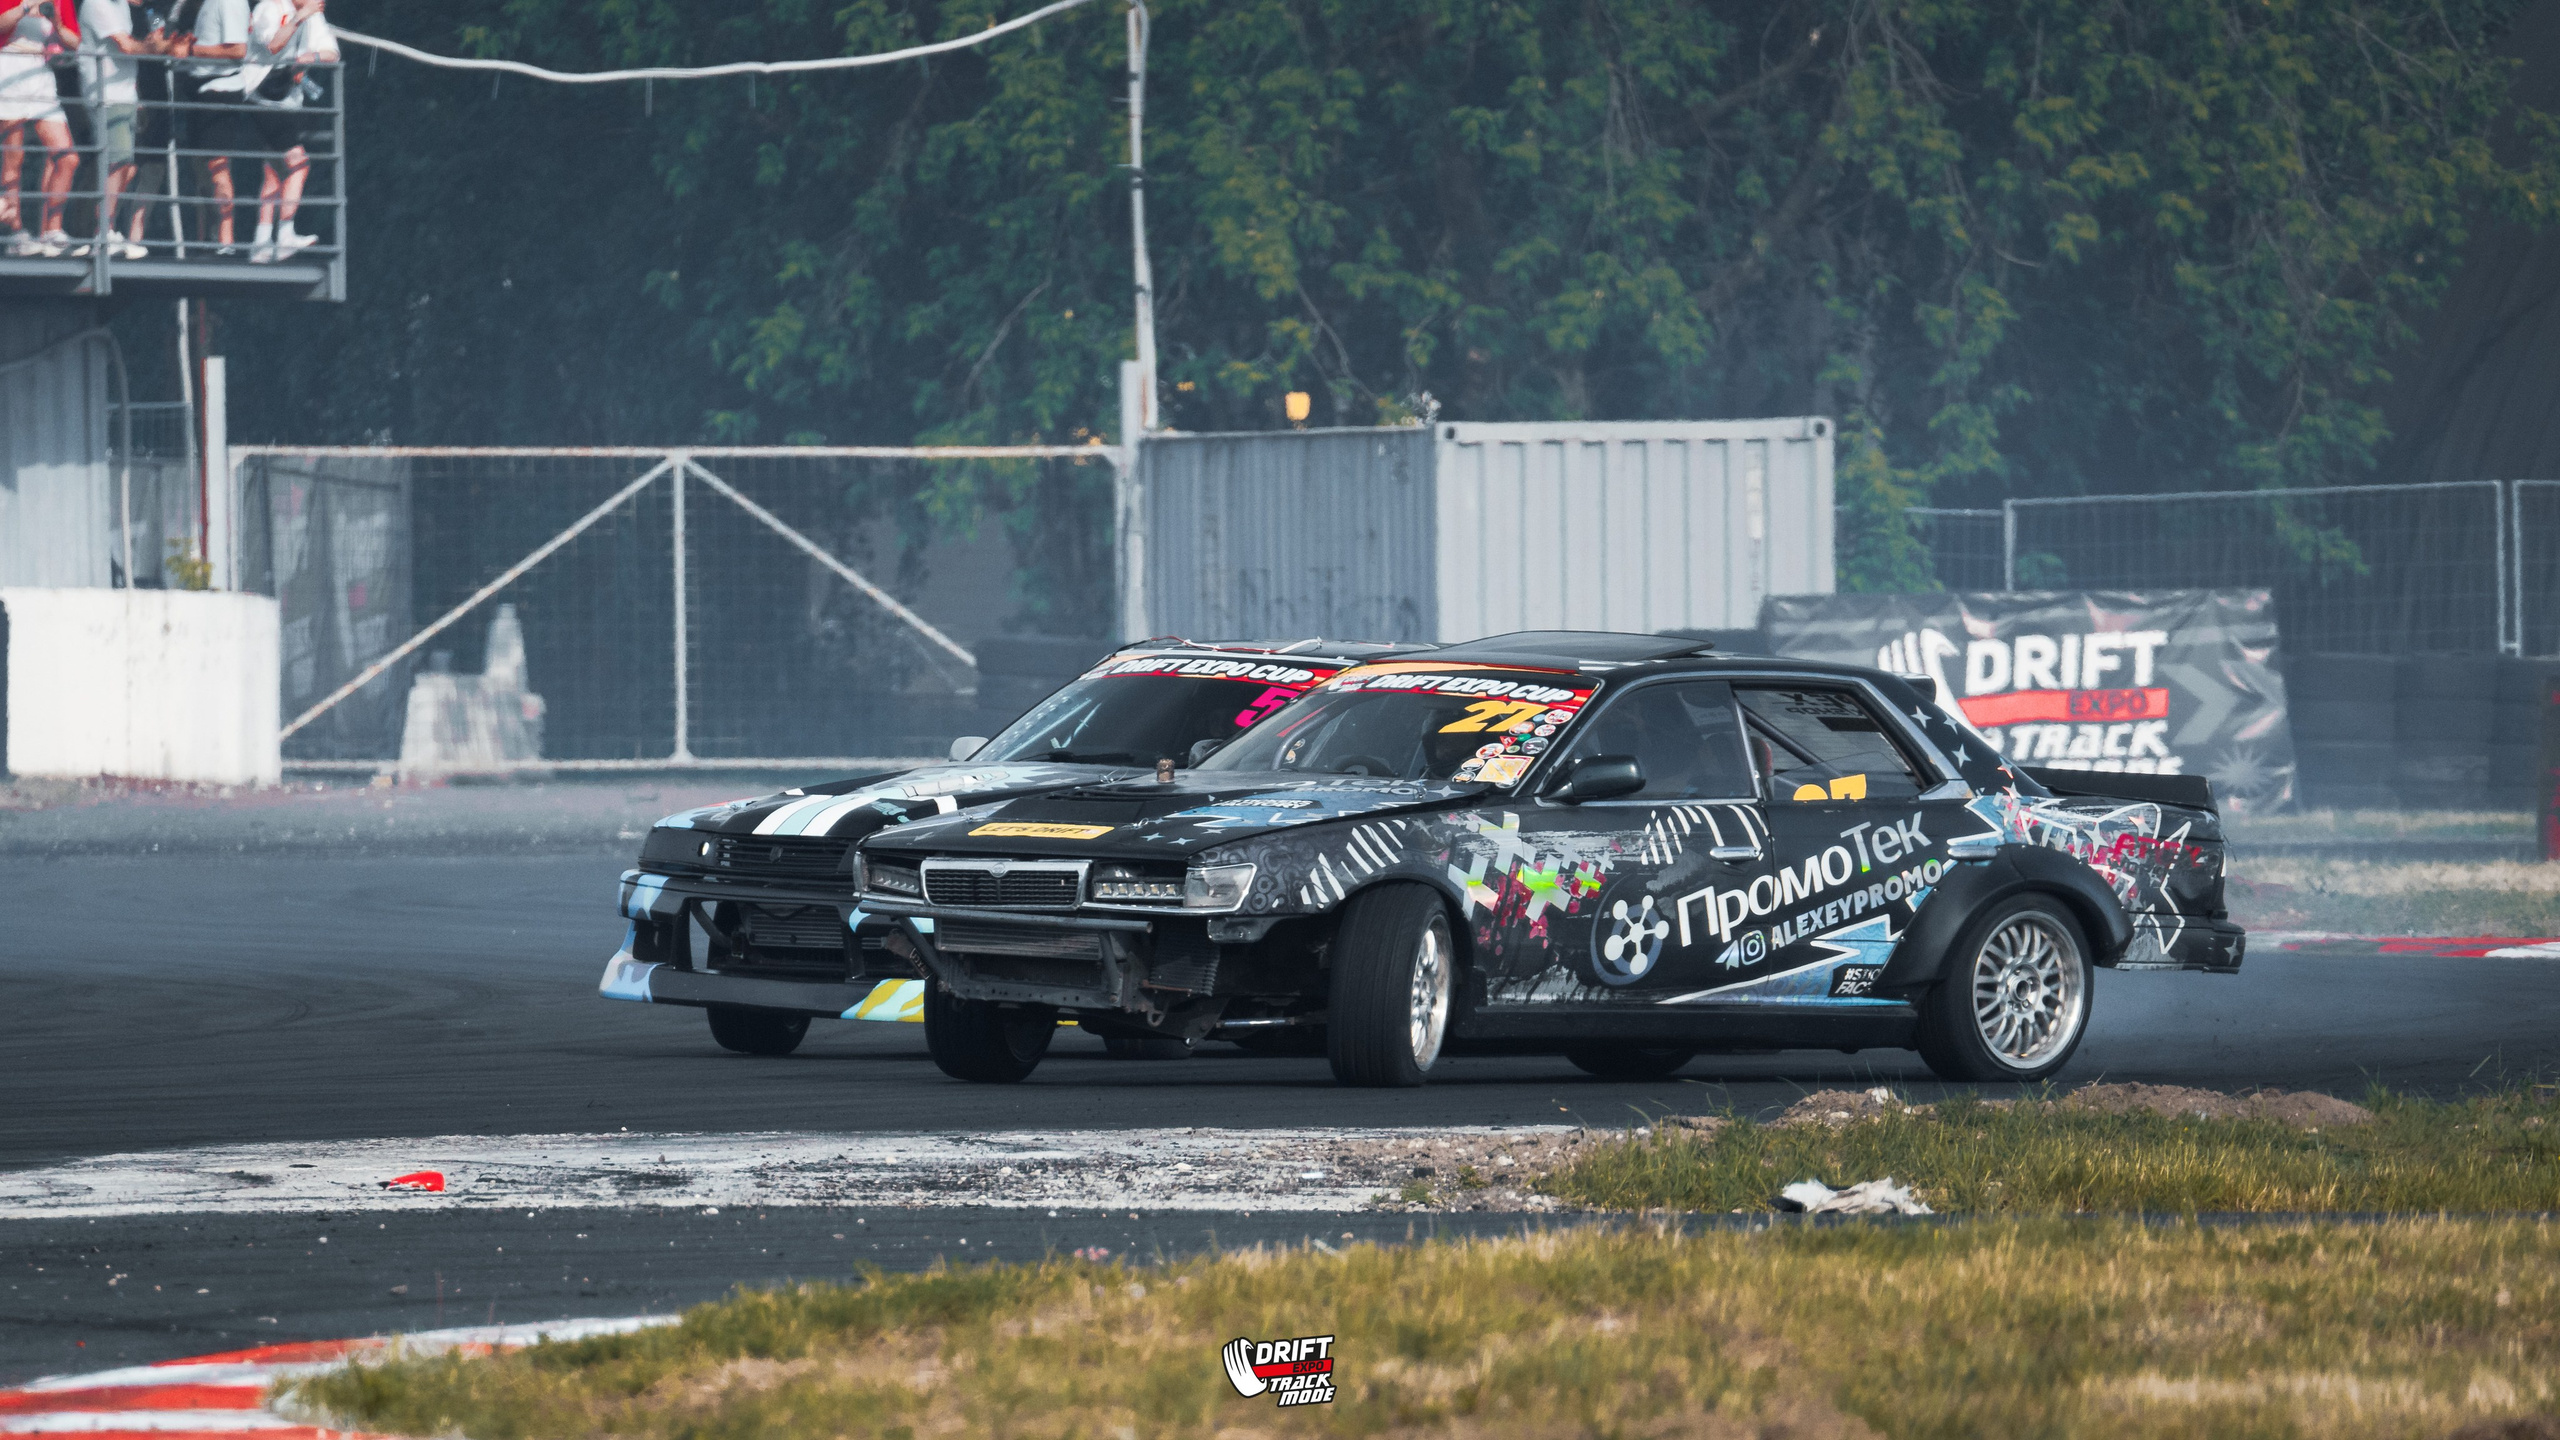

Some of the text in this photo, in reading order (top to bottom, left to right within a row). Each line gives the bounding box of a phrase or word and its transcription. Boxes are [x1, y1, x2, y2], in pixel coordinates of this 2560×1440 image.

[1110, 658, 1192, 675] DRIFT
[1178, 659, 1252, 677] EXPO
[1248, 664, 1315, 684] CUP
[1965, 630, 2169, 695] DRIFT
[1365, 674, 1441, 691] DRIFT
[1435, 677, 1518, 697] EXPO
[1508, 684, 1575, 703] CUP
[2069, 688, 2148, 716] EXPO
[1438, 700, 1550, 733] 27
[2010, 720, 2169, 762] TRACK
[1771, 858, 1943, 951] ALEXEYPROMO
